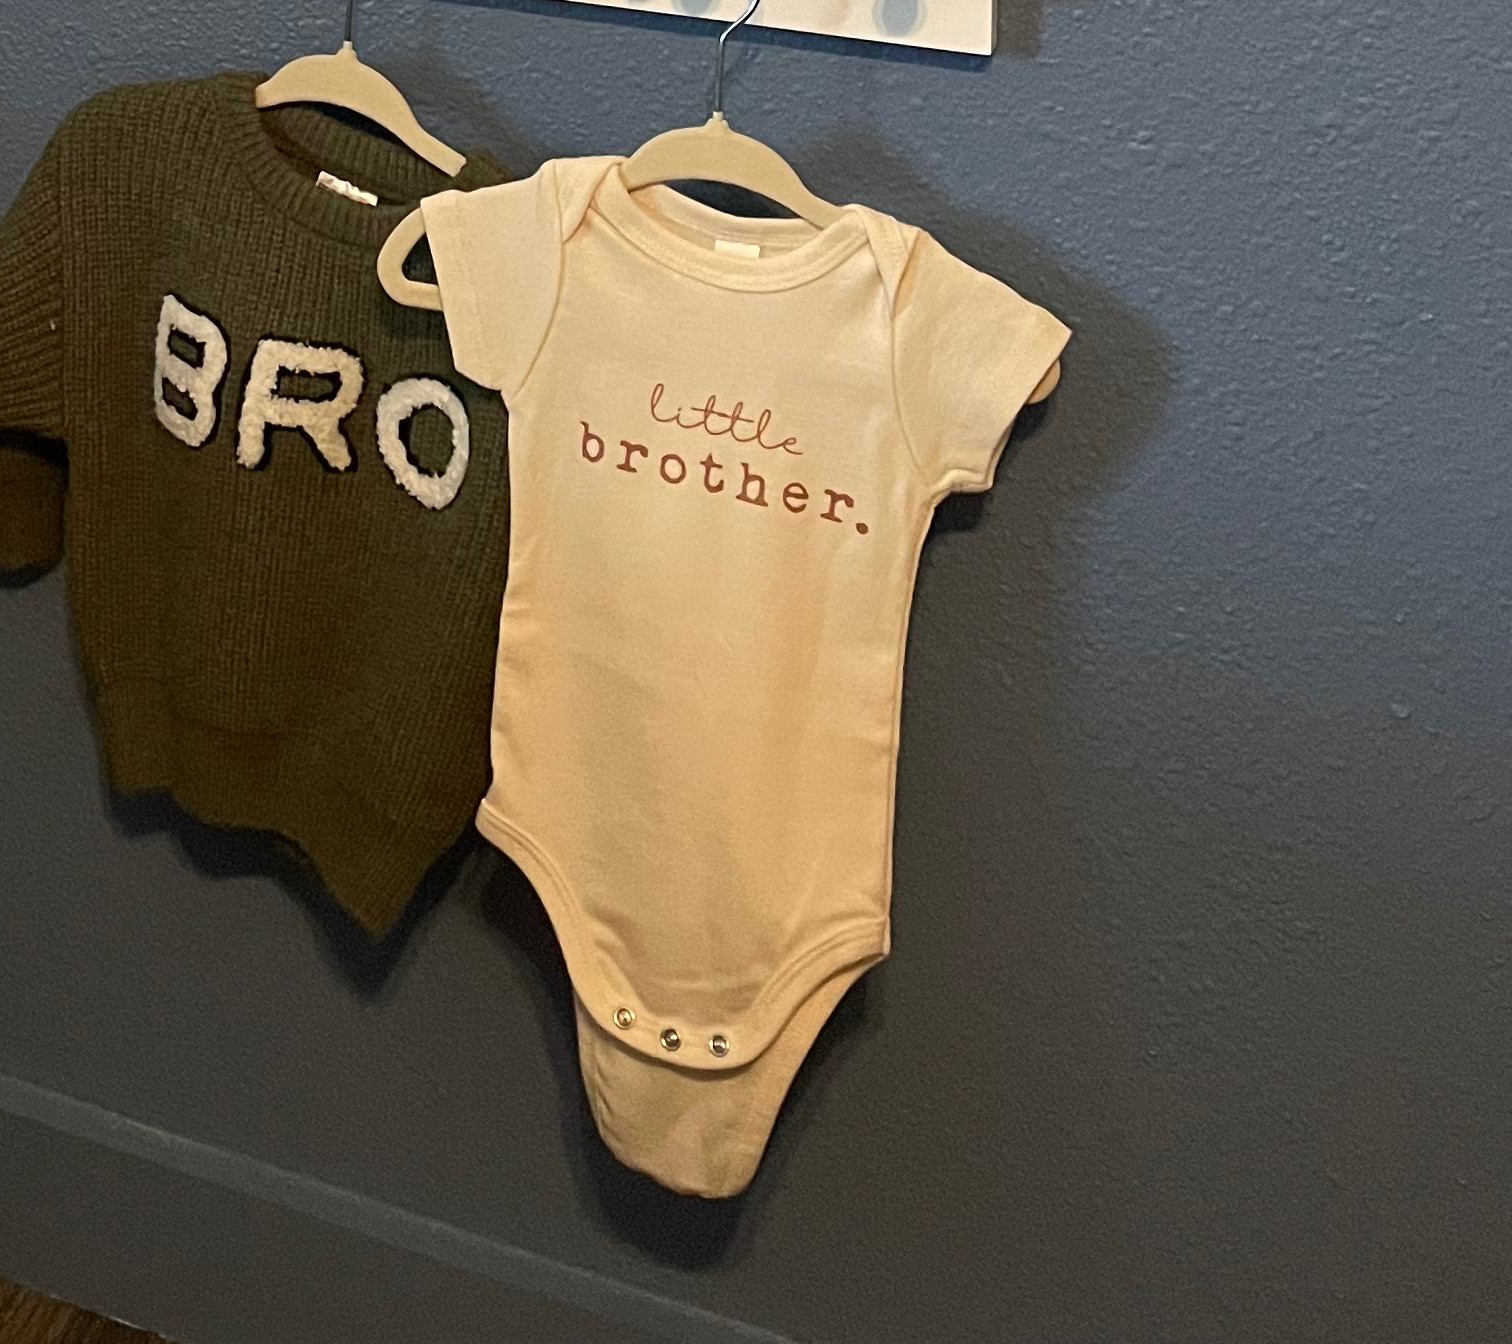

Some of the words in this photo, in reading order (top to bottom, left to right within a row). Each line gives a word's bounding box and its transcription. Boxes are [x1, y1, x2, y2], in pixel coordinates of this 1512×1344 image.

[153, 293, 472, 511] BRO
[649, 382, 806, 457] little
[579, 422, 870, 536] brother.
